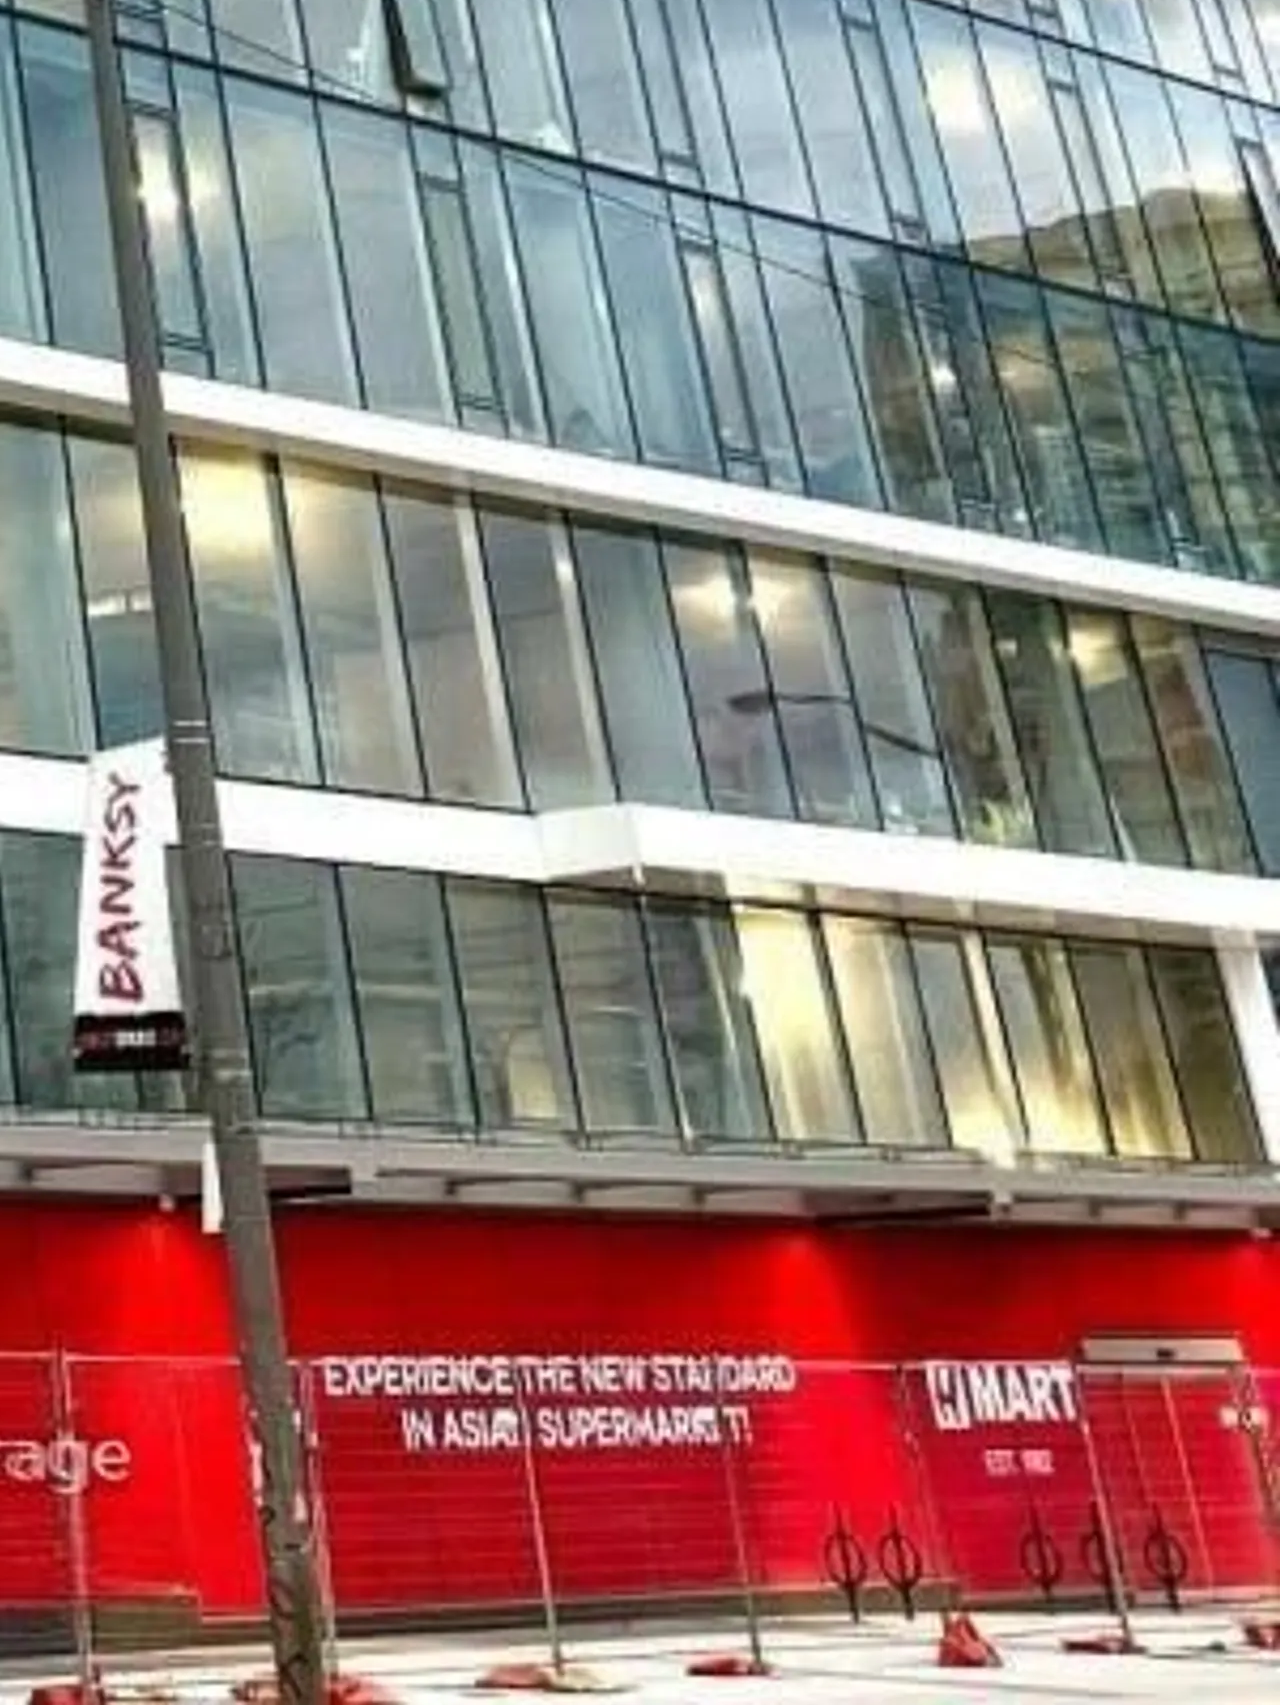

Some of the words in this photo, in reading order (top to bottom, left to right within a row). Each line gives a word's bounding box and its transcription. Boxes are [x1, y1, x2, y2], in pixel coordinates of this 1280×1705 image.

[94, 772, 145, 1004] BANKSY
[324, 1355, 514, 1396] EXPERIENCE
[517, 1355, 578, 1394] THE
[580, 1355, 646, 1394] NEW
[968, 1363, 1078, 1422] MART
[402, 1408, 435, 1451] IN
[537, 1405, 753, 1448] SUPERMARKT!
